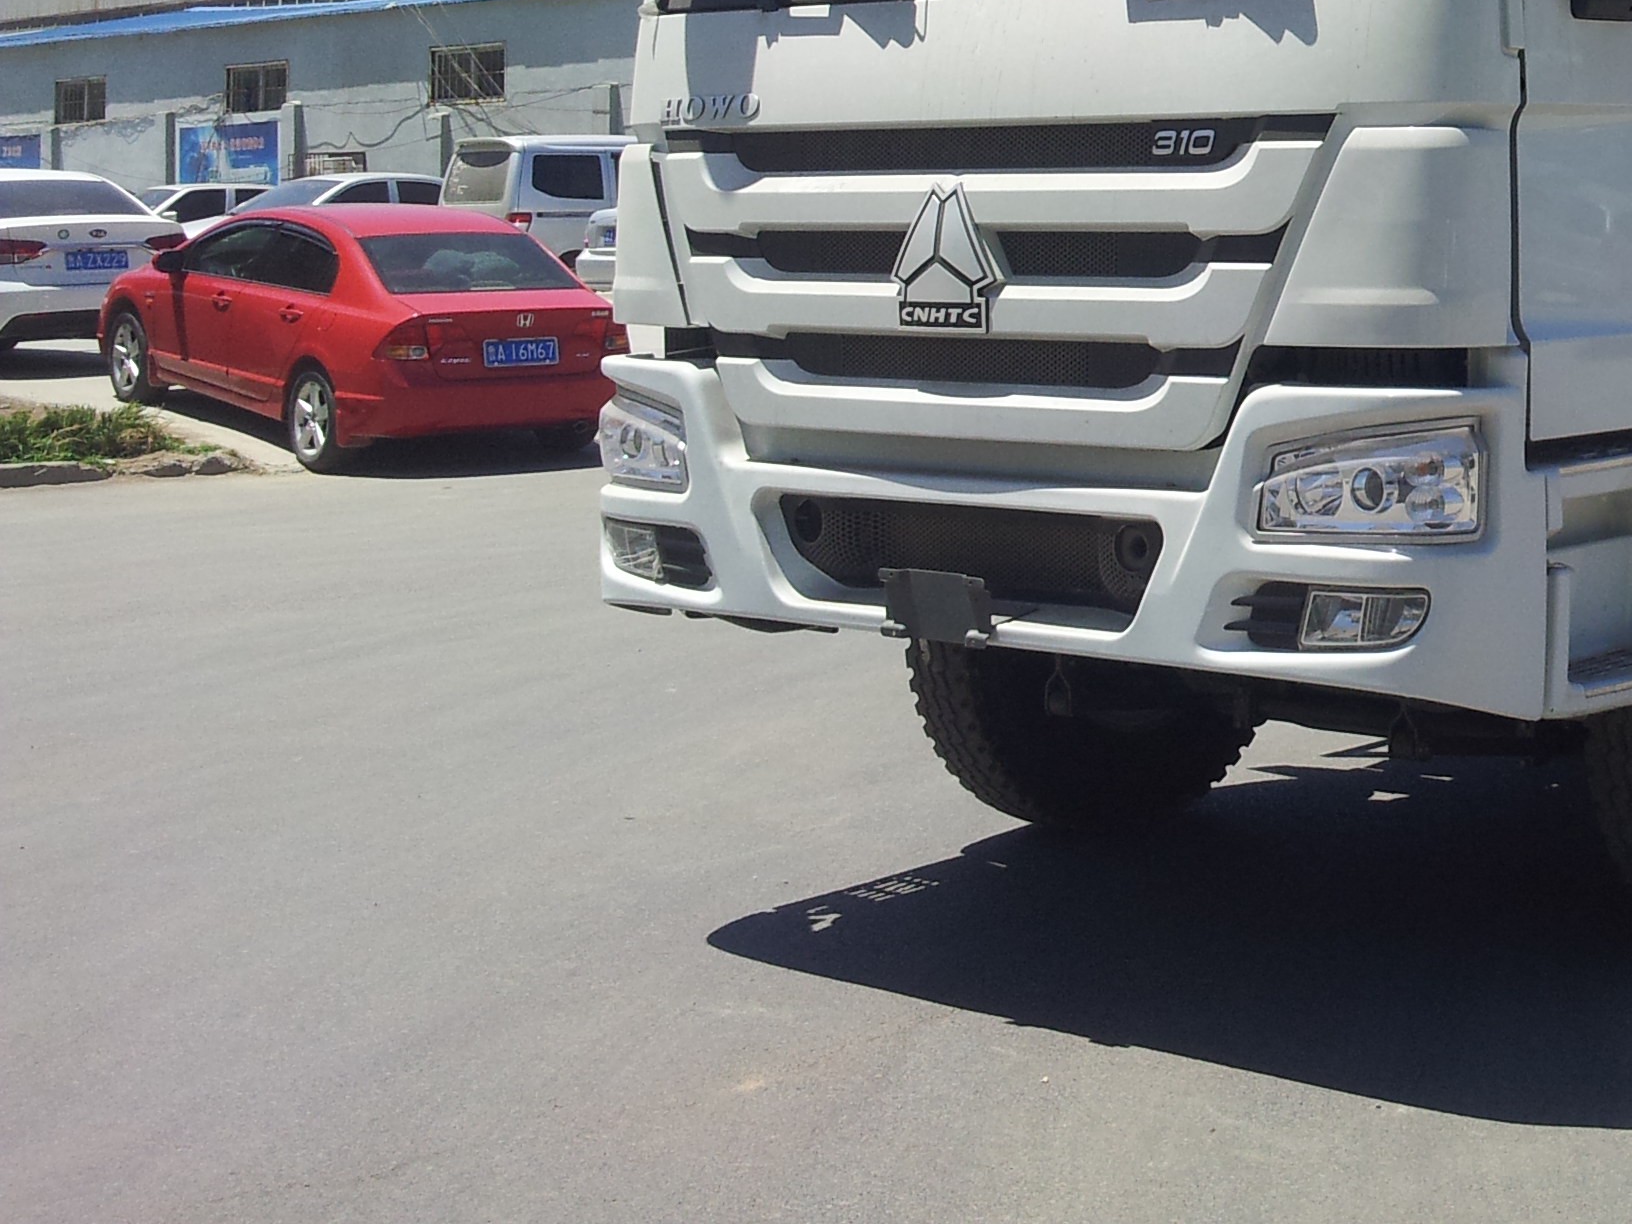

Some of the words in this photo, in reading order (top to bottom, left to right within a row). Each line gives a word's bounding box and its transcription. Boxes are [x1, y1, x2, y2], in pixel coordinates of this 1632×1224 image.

[660, 93, 761, 124] HOWO
[1152, 129, 1216, 155] 310
[901, 306, 979, 324] CNHTC
